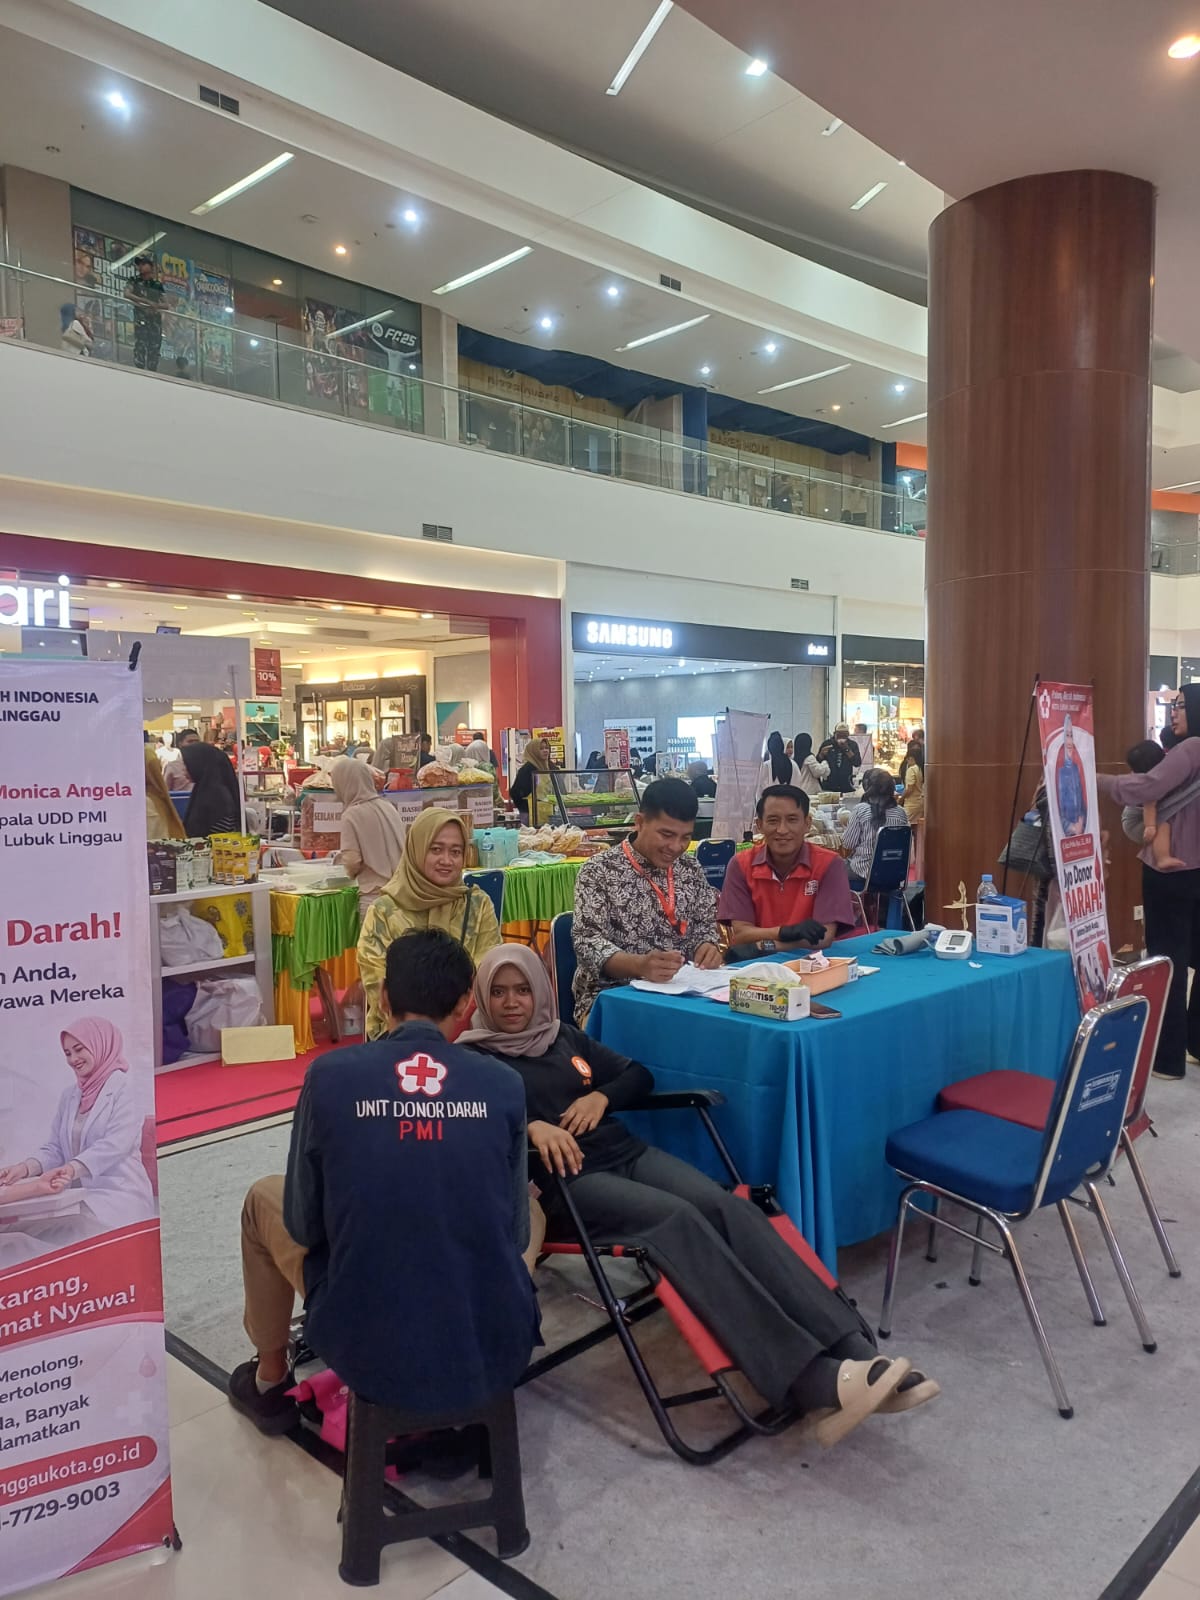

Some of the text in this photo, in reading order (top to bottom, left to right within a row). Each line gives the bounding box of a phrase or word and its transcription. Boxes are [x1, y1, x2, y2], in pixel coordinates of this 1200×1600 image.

[0, 574, 71, 628] ari
[586, 621, 673, 649] SAMSUNG
[258, 671, 277, 682] 10%
[14, 691, 99, 704] INDONESIA
[0, 710, 61, 722] INGGAU
[66, 782, 132, 800] Angela
[38, 812, 73, 825] UDD
[78, 811, 107, 824] PMI
[4, 832, 123, 848] Lubuk Linggau
[1073, 865, 1093, 884] Donor
[7, 912, 121, 947] Darah!
[12, 962, 77, 984] Anda,
[0, 984, 125, 1010] awa Mereka
[356, 1099, 488, 1119] UNIT DONOR DARAH
[400, 1120, 444, 1141] PMI
[49, 1285, 136, 1324] Nyawa!
[0, 1376, 72, 1404] ertolong
[26, 1394, 90, 1423] Banyak
[0, 1481, 121, 1530] -7729-9003
